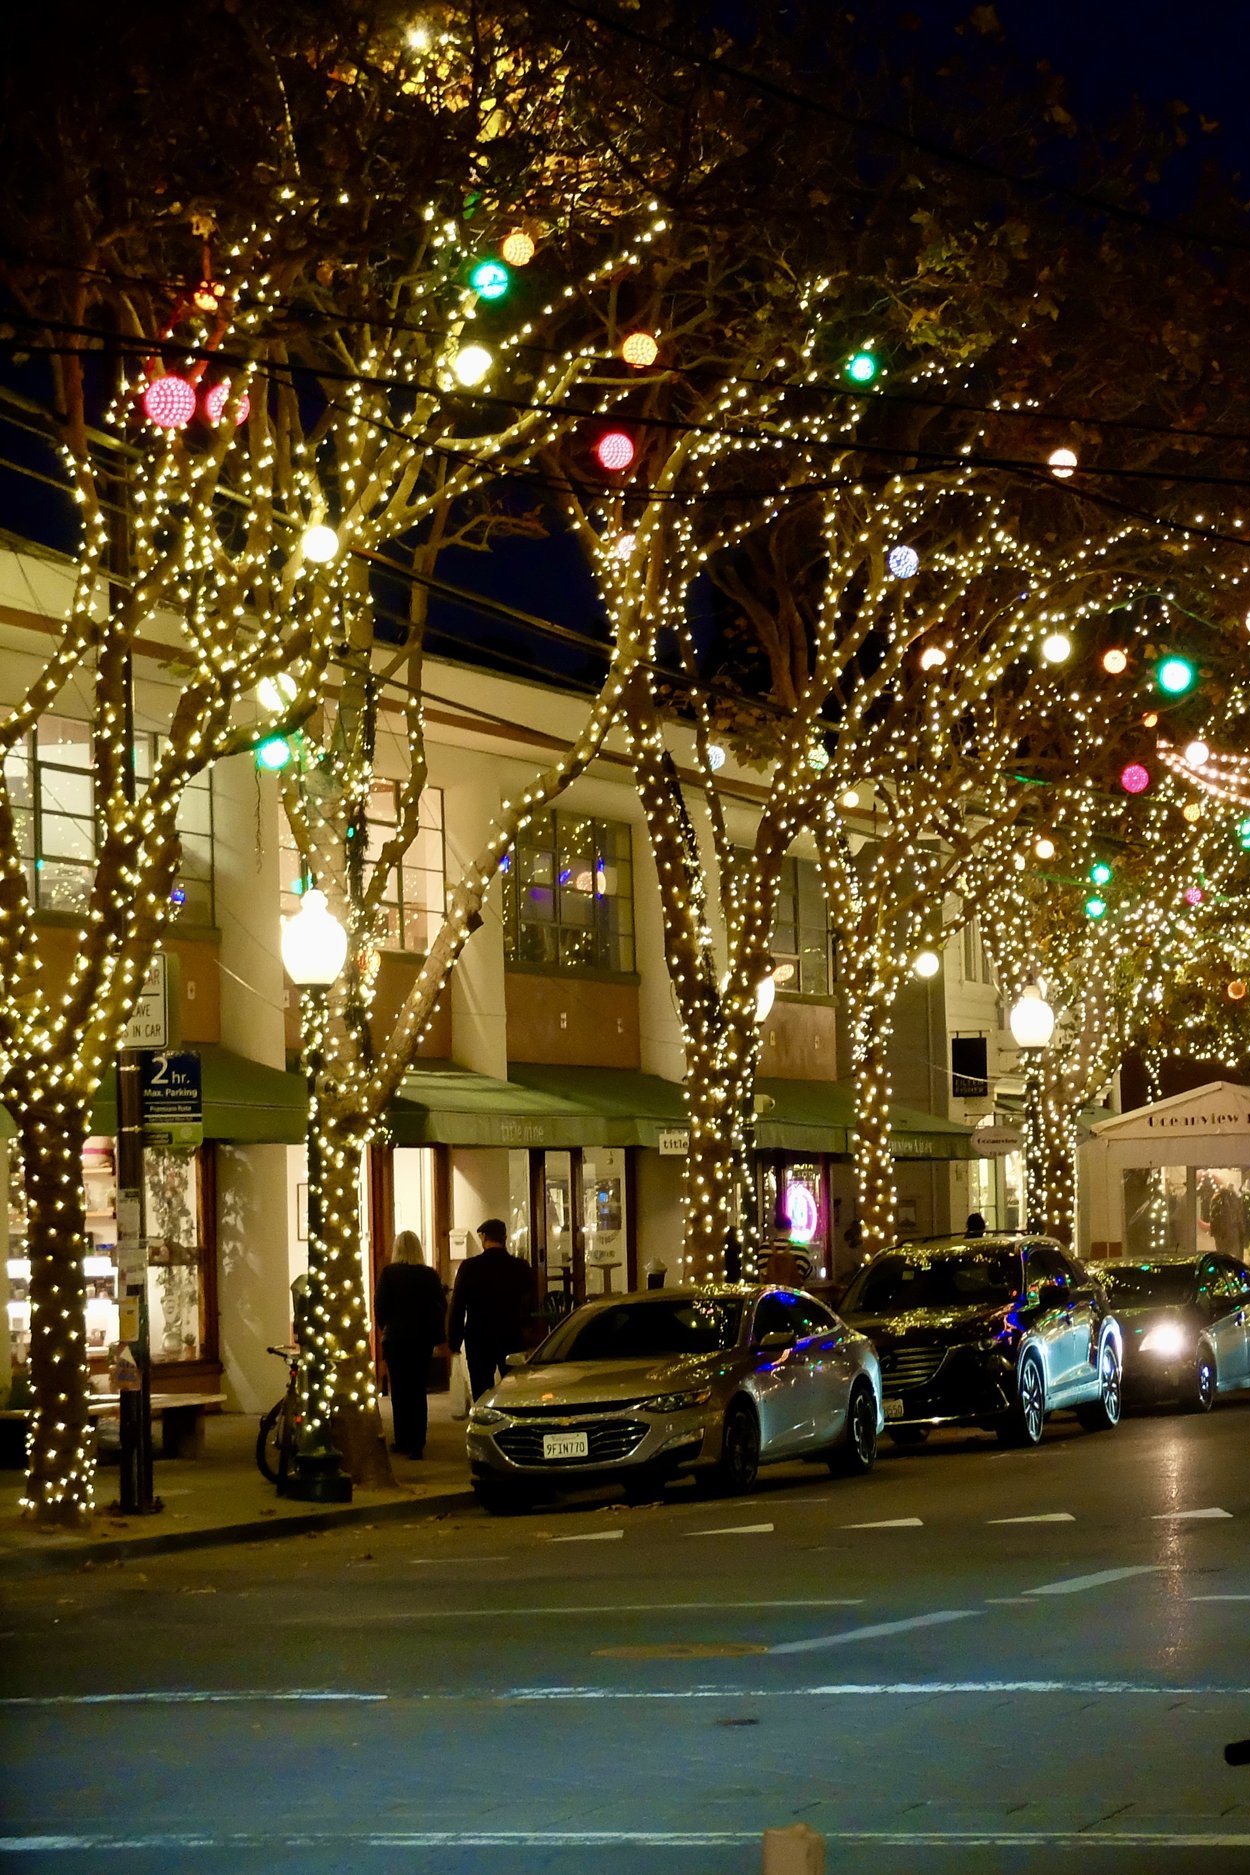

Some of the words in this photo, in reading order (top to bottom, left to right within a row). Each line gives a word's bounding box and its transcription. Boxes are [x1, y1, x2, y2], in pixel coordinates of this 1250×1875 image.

[132, 1024, 141, 1038] IN
[145, 1023, 161, 1038] CAR
[151, 1056, 169, 1084] 2
[172, 1071, 191, 1084] hr.
[143, 1089, 164, 1097] Max.
[165, 1087, 198, 1098] Parking
[1148, 1112, 1239, 1127] Oceanview
[663, 1138, 689, 1149] title
